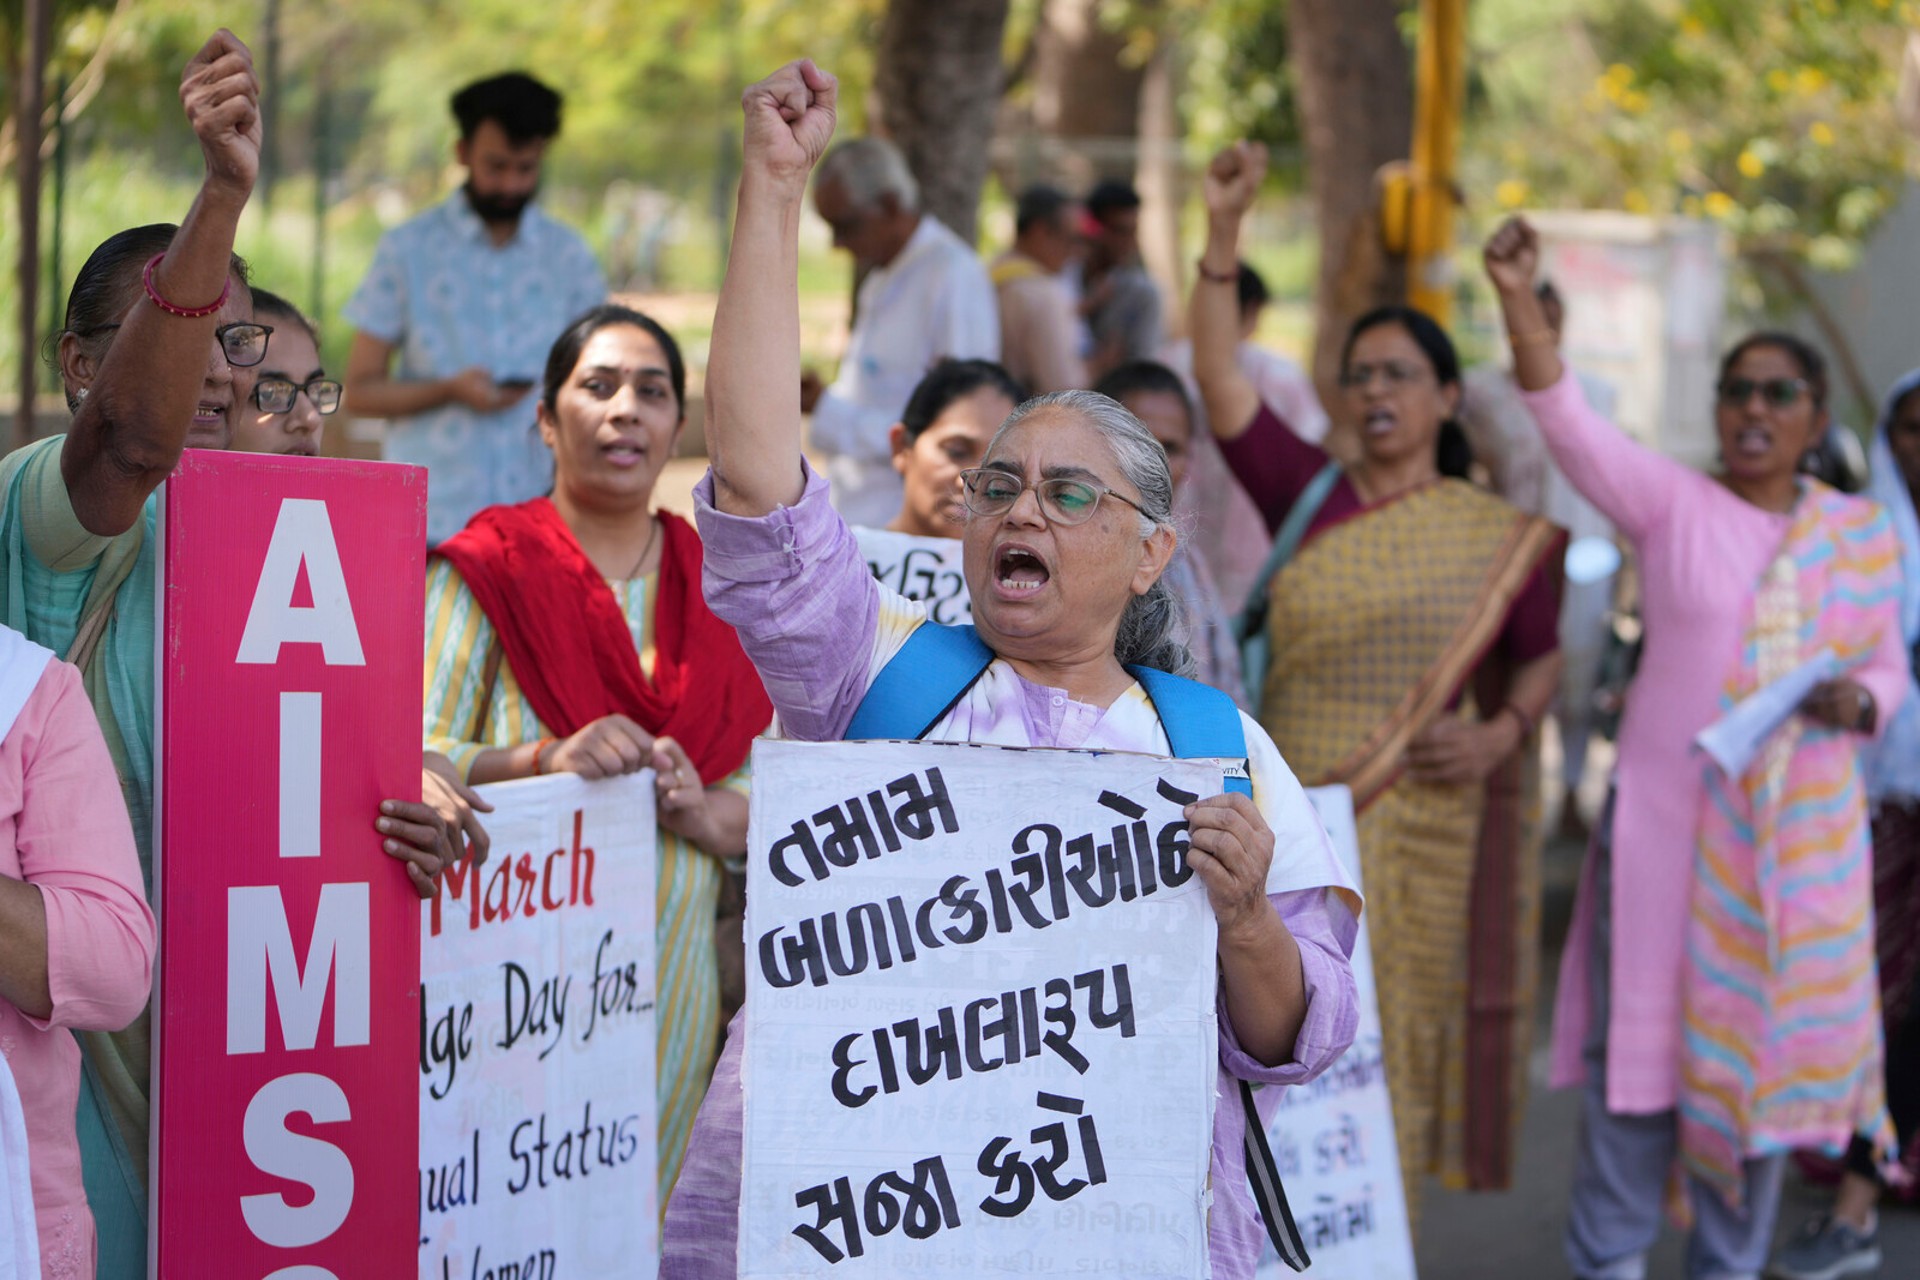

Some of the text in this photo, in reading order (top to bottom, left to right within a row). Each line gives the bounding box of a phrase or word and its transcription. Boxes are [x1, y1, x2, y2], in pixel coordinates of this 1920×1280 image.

[226, 498, 370, 1280] AIMS
[431, 808, 595, 937] March
[769, 767, 959, 887] તમામ
[420, 983, 473, 1101] ge
[497, 962, 571, 1061] Day
[832, 964, 1136, 1108] દાખલારૂપ
[419, 1101, 638, 1247] ual Status
[792, 1091, 1107, 1264] સજા કરો
